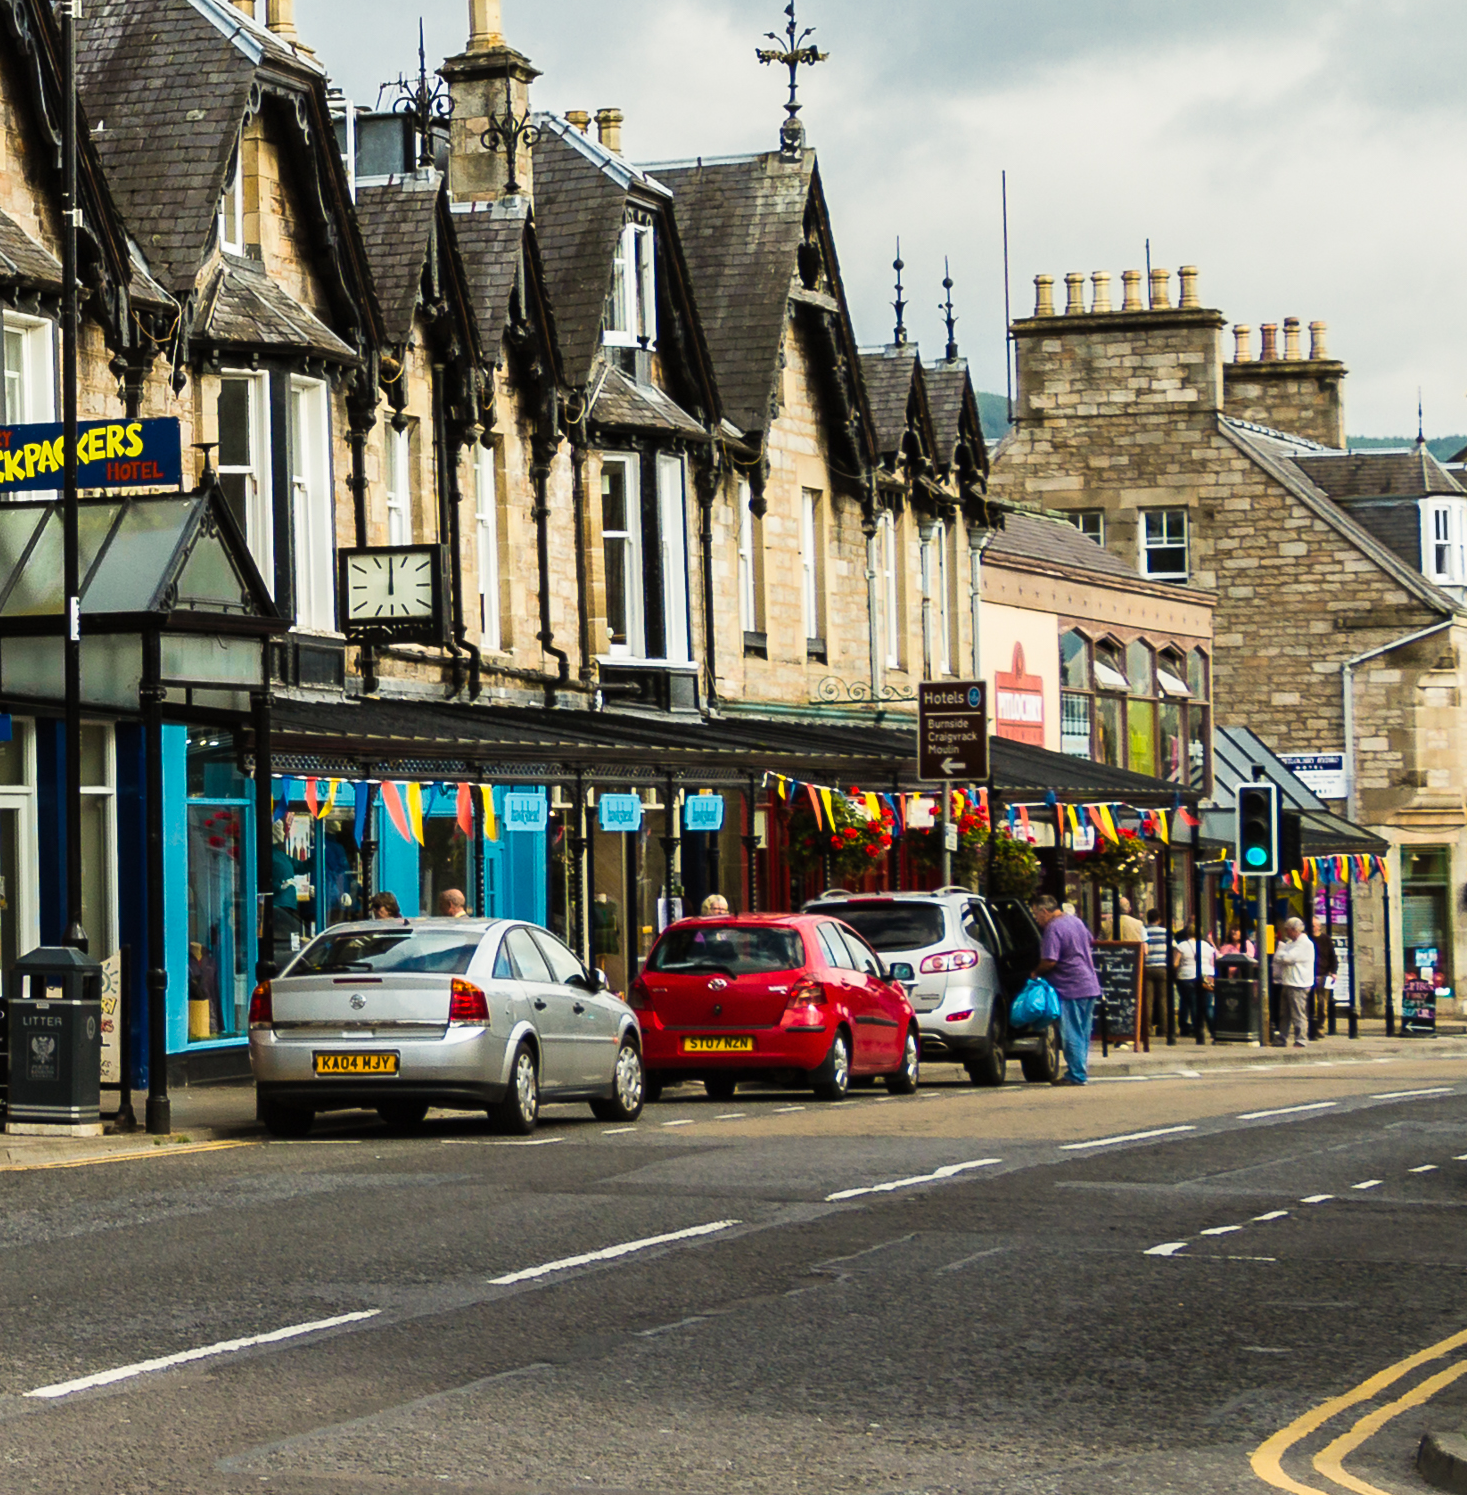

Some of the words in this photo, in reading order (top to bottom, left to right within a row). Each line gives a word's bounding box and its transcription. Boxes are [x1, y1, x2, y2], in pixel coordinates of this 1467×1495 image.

[106, 461, 164, 481] HOTEL
[924, 691, 964, 704] Hotels
[928, 719, 969, 729] Burnside
[928, 731, 977, 743] Craigvrack
[928, 745, 959, 754] Moulin
[22, 1016, 62, 1026] LITTER
[322, 1056, 358, 1070] KA04
